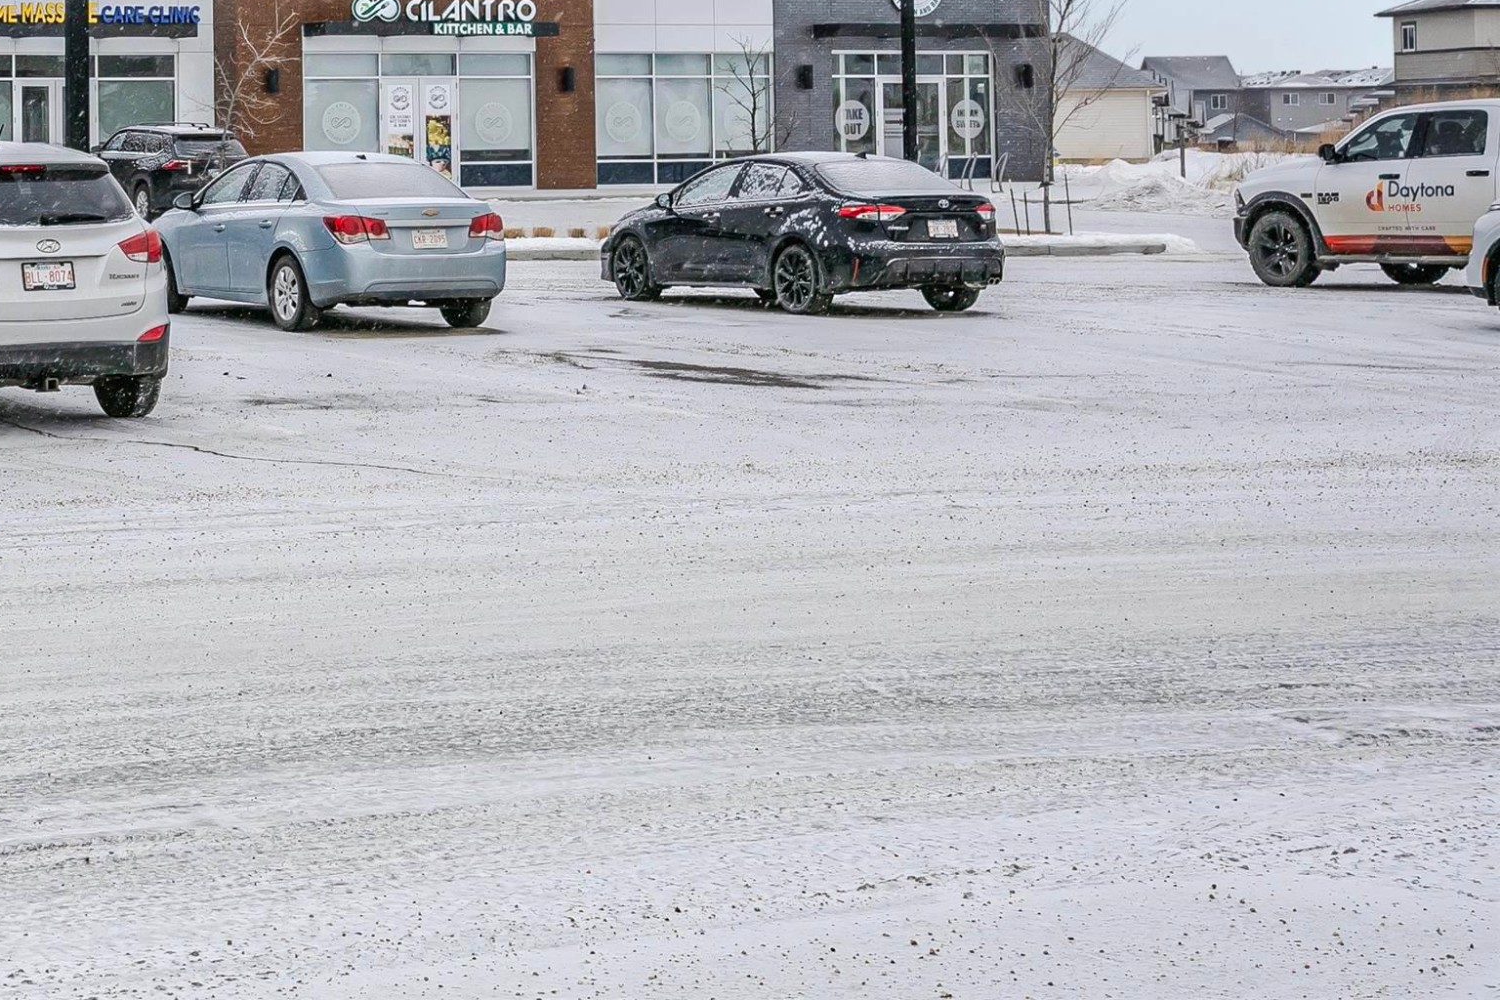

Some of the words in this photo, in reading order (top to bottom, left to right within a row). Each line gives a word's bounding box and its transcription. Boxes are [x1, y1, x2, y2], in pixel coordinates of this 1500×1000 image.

[20, 2, 99, 24] MASSE
[101, 6, 145, 24] CARE
[149, 6, 201, 24] CLINIC
[405, 0, 537, 22] CILANTRO
[434, 23, 493, 35] KITTCHEN
[495, 23, 505, 35] &
[507, 23, 532, 35] BAR
[844, 123, 861, 135] OUT
[1388, 180, 1454, 202] Daytona
[1388, 204, 1421, 212] HOMES
[25, 270, 73, 284] BLL-8074
